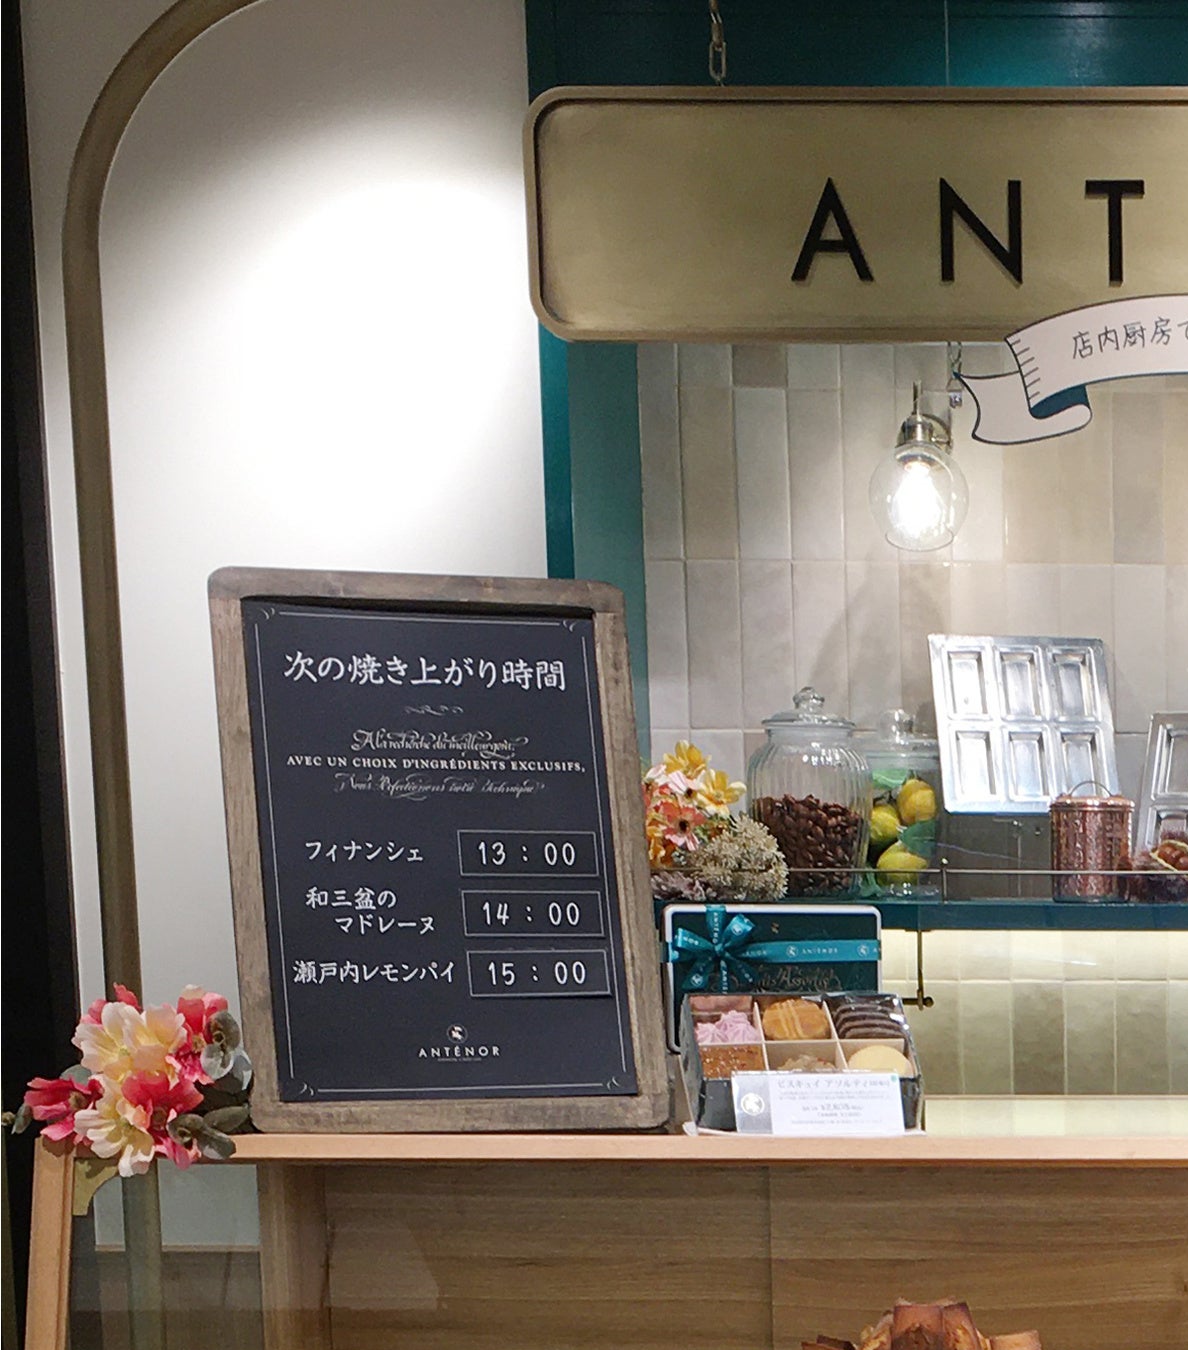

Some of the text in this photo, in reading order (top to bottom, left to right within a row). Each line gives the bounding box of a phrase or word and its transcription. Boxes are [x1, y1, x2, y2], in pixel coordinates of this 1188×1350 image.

[283, 651, 566, 692] 次の焼き上がり時間
[287, 755, 586, 773] AVEC UN CHOIX D'INGRÉDIENTS EXCLUSIFS,
[304, 839, 424, 864] フィナンシェ
[304, 886, 397, 911] 和三盆の
[334, 912, 436, 935] マドレーヌ
[292, 959, 455, 986] 瀬戸内レモンパイ
